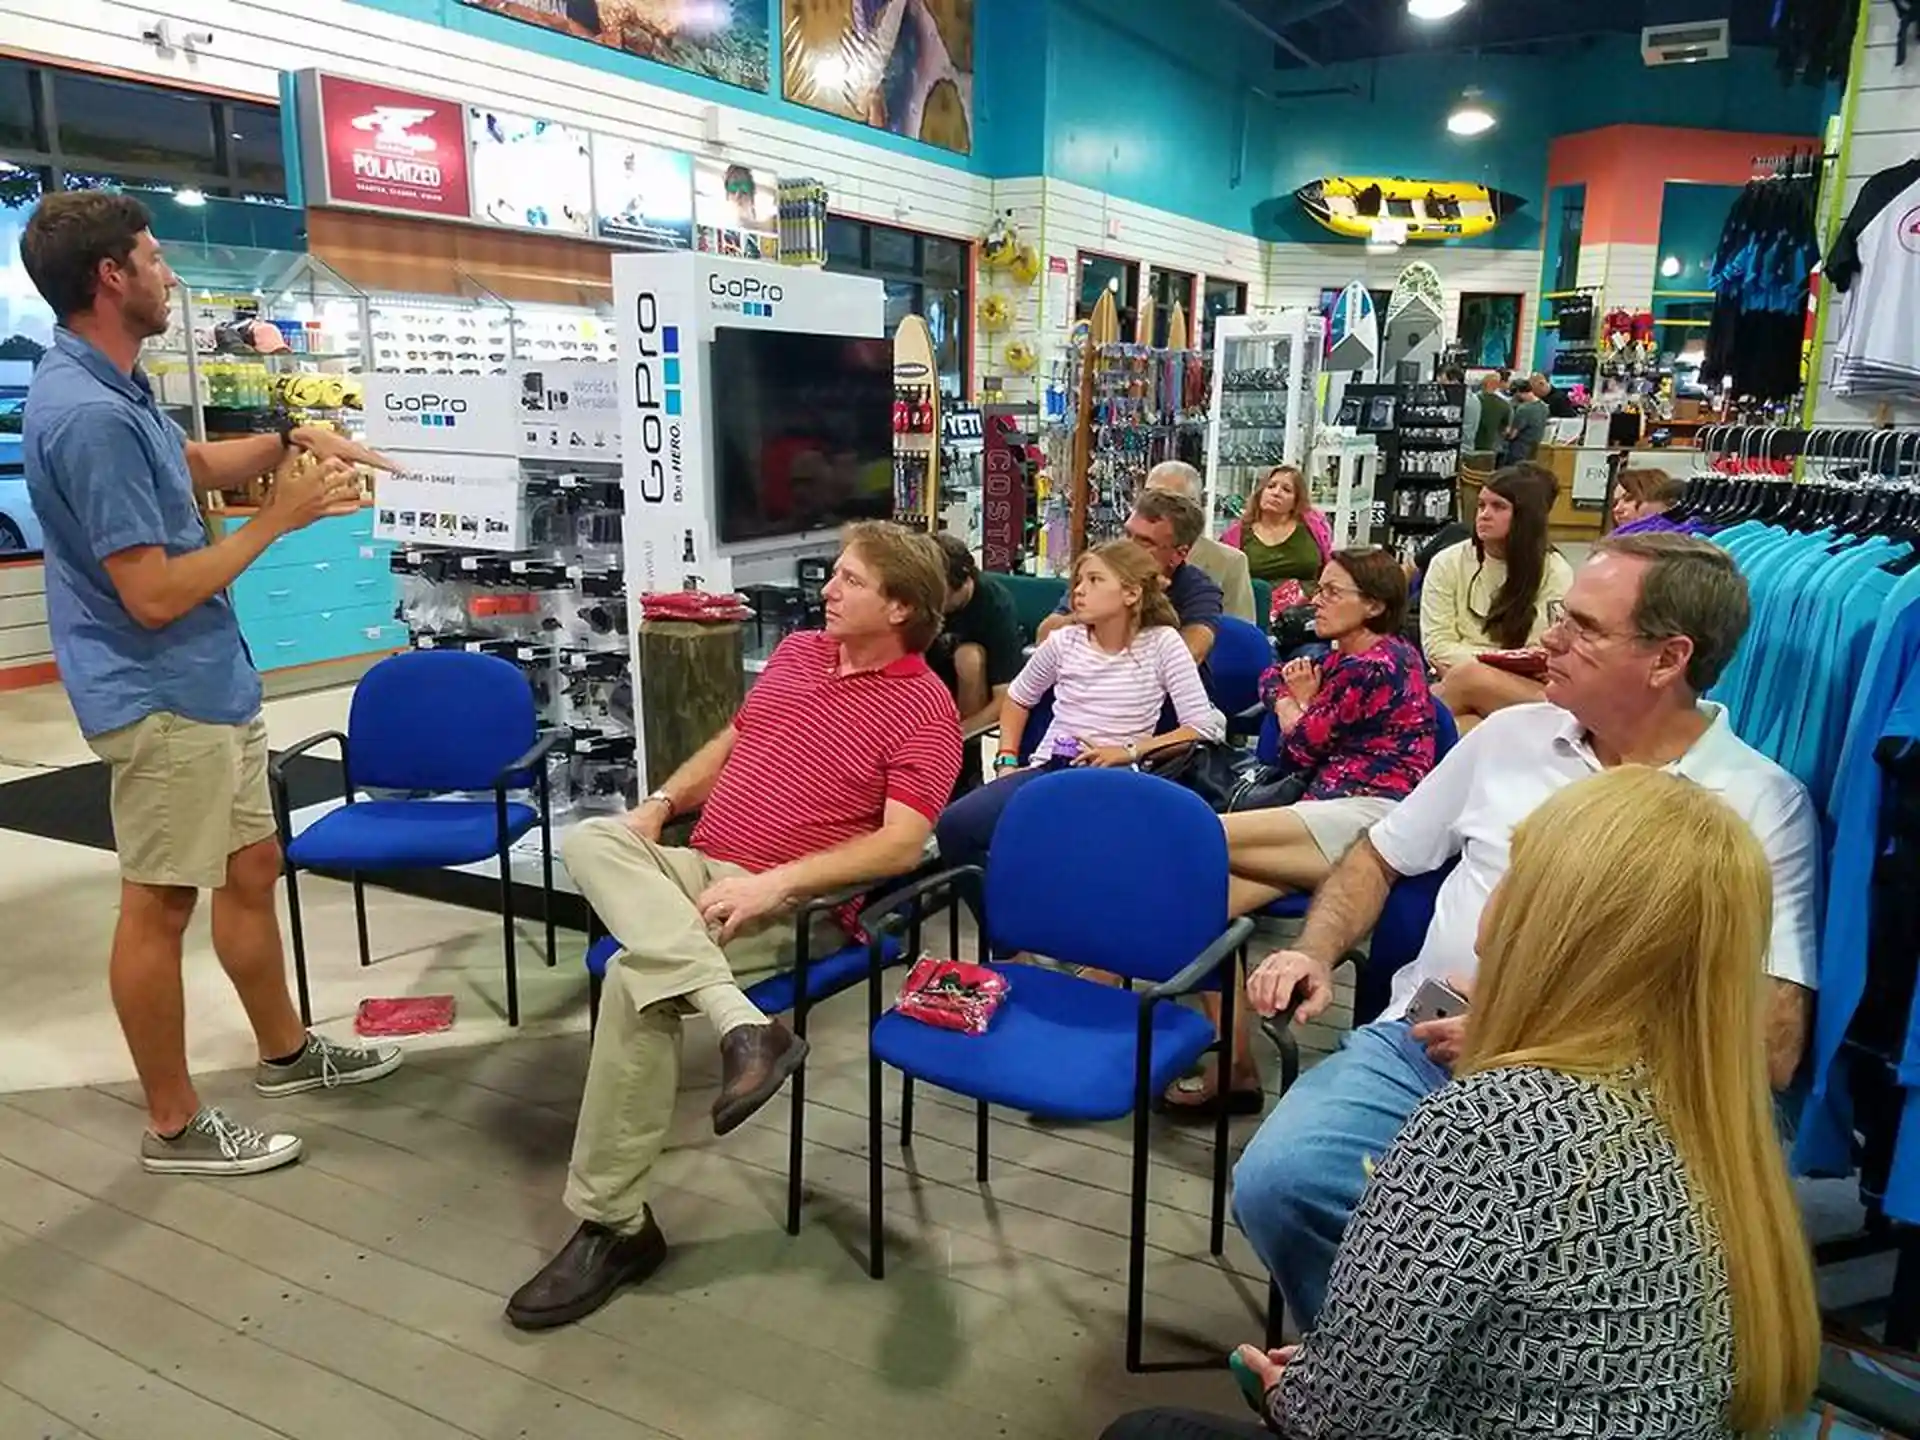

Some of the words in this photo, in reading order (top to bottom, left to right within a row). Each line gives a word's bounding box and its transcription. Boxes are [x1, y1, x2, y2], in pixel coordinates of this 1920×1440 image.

[352, 153, 441, 187] POLARIZED
[709, 273, 783, 302] GoPro
[384, 393, 468, 413] GoPro
[636, 291, 665, 504] GoPro
[947, 413, 982, 436] YETI
[987, 449, 1012, 567] COSTA
